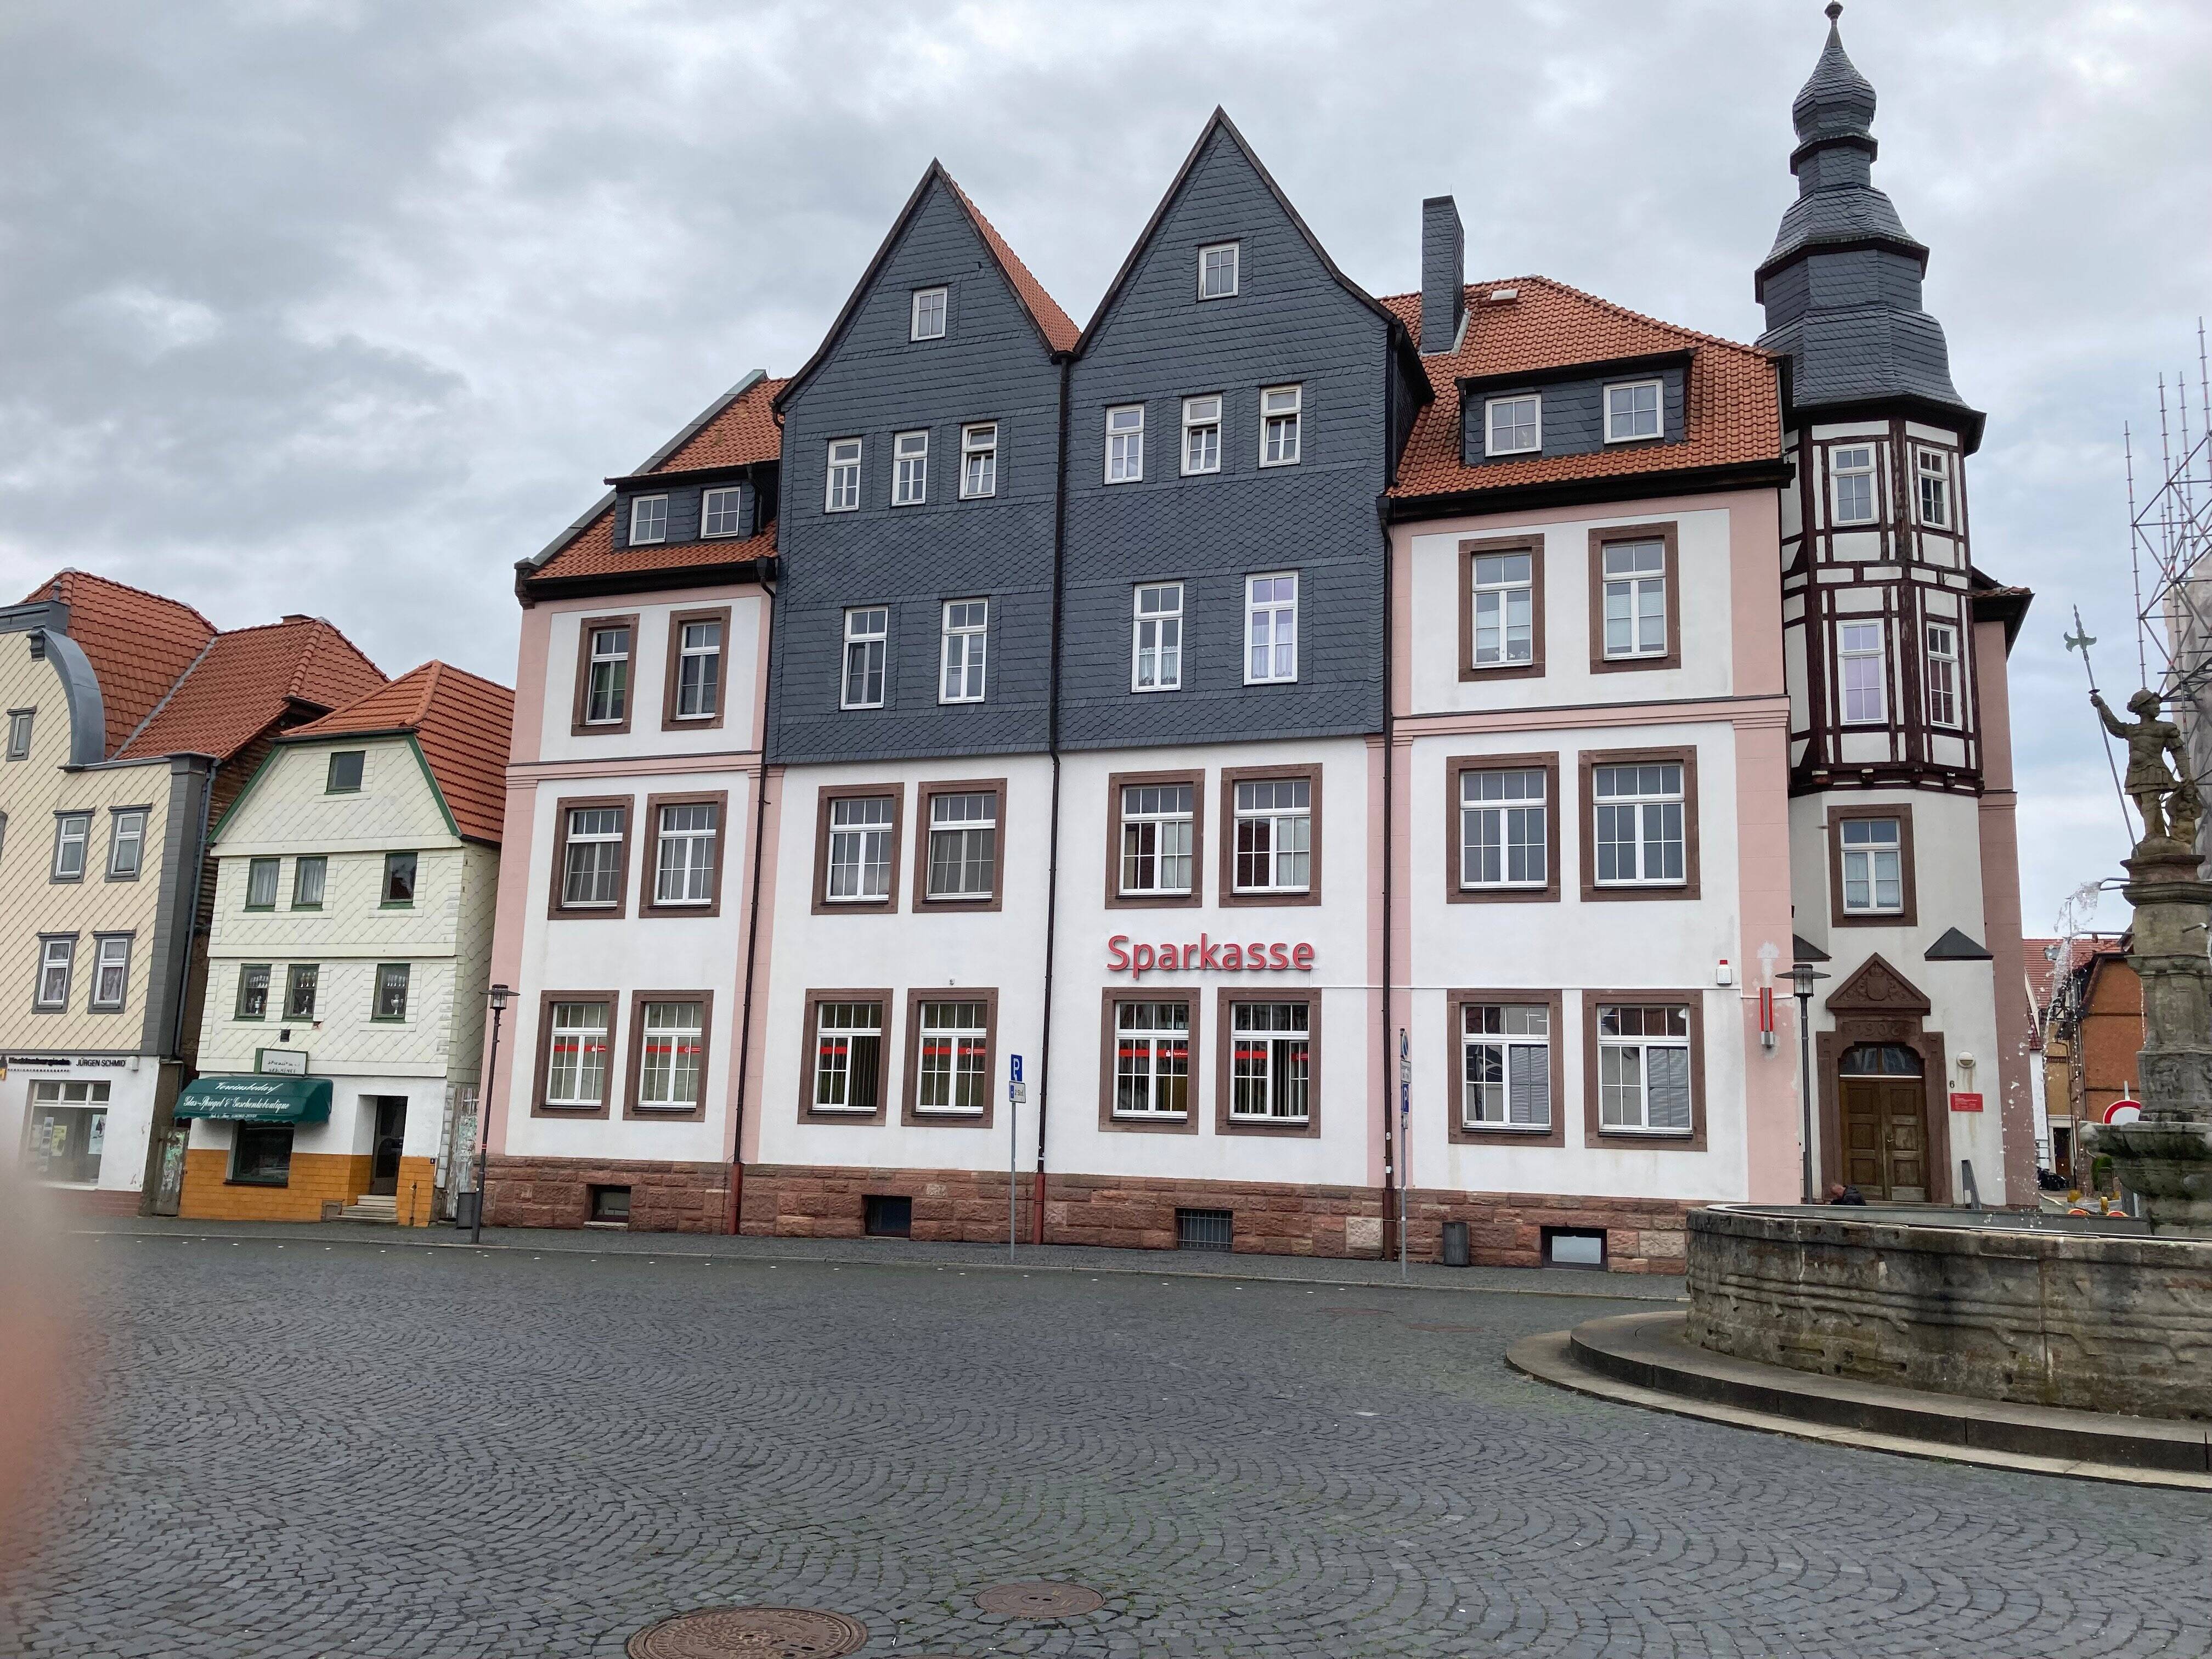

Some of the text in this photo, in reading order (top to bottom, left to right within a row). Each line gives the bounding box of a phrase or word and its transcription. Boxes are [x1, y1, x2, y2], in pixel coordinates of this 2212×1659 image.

[1107, 933, 1314, 979] Sparkasse
[76, 1058, 100, 1066] JÜRGEN
[1013, 1058, 1019, 1079] P
[215, 1082, 284, 1094] Vereinsbedarf
[1949, 1080, 1955, 1088] 6
[183, 1096, 225, 1111] Glas-Spiegel
